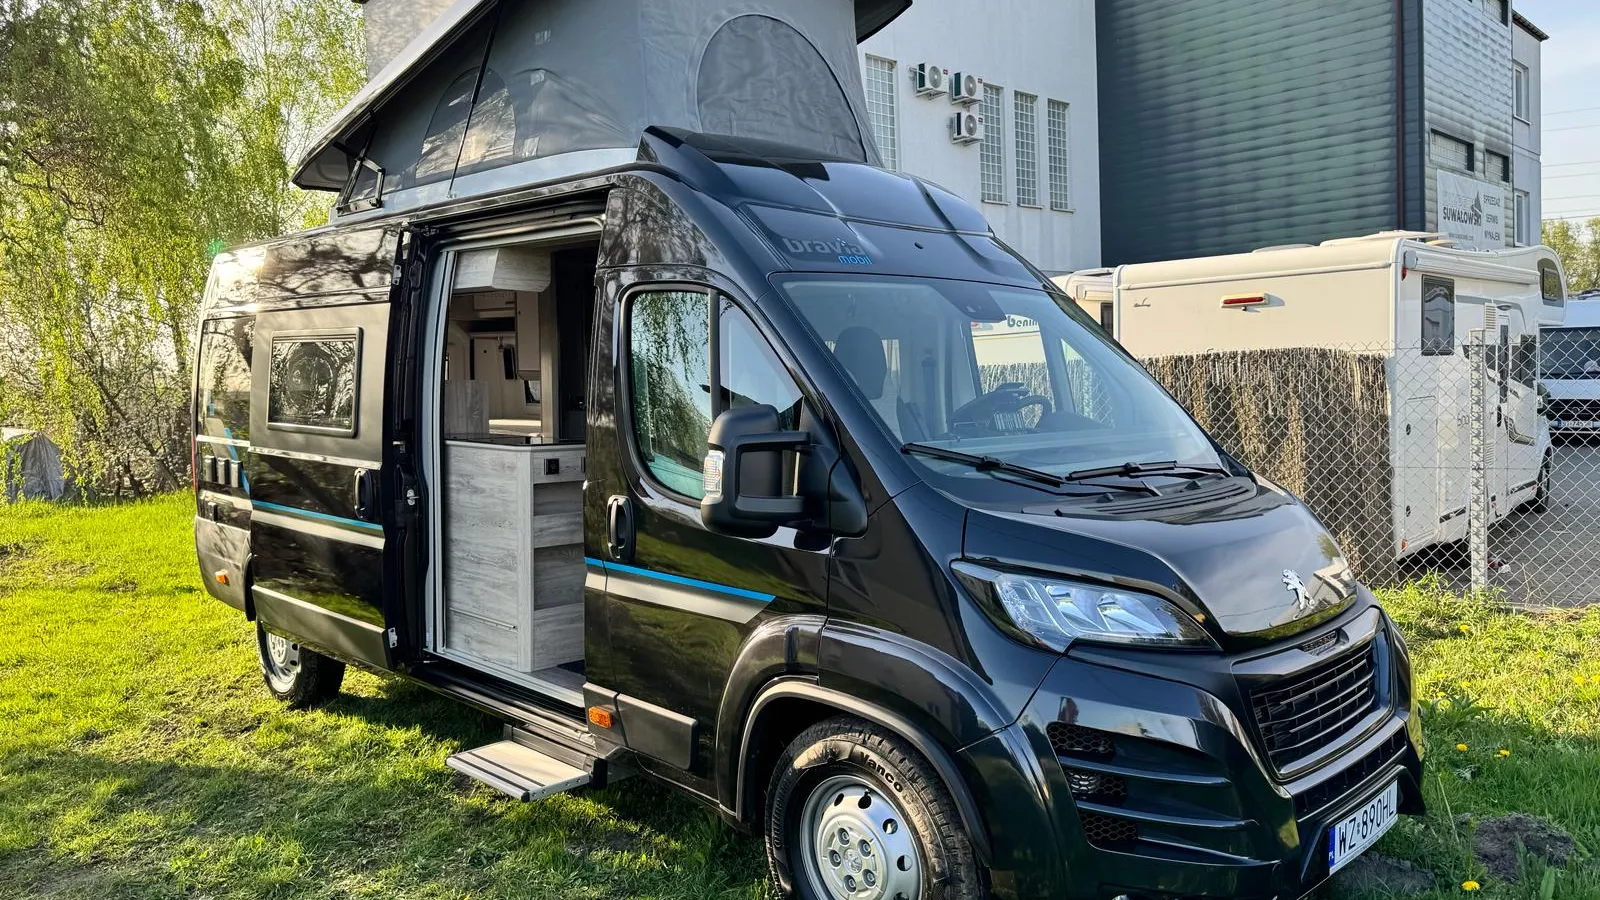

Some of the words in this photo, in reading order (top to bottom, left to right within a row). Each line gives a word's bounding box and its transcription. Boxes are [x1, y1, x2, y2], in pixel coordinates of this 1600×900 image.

[782, 237, 867, 256] bravia
[838, 254, 873, 265] mobil
[1338, 816, 1357, 857] WZ
[1362, 790, 1394, 839] 890HL
